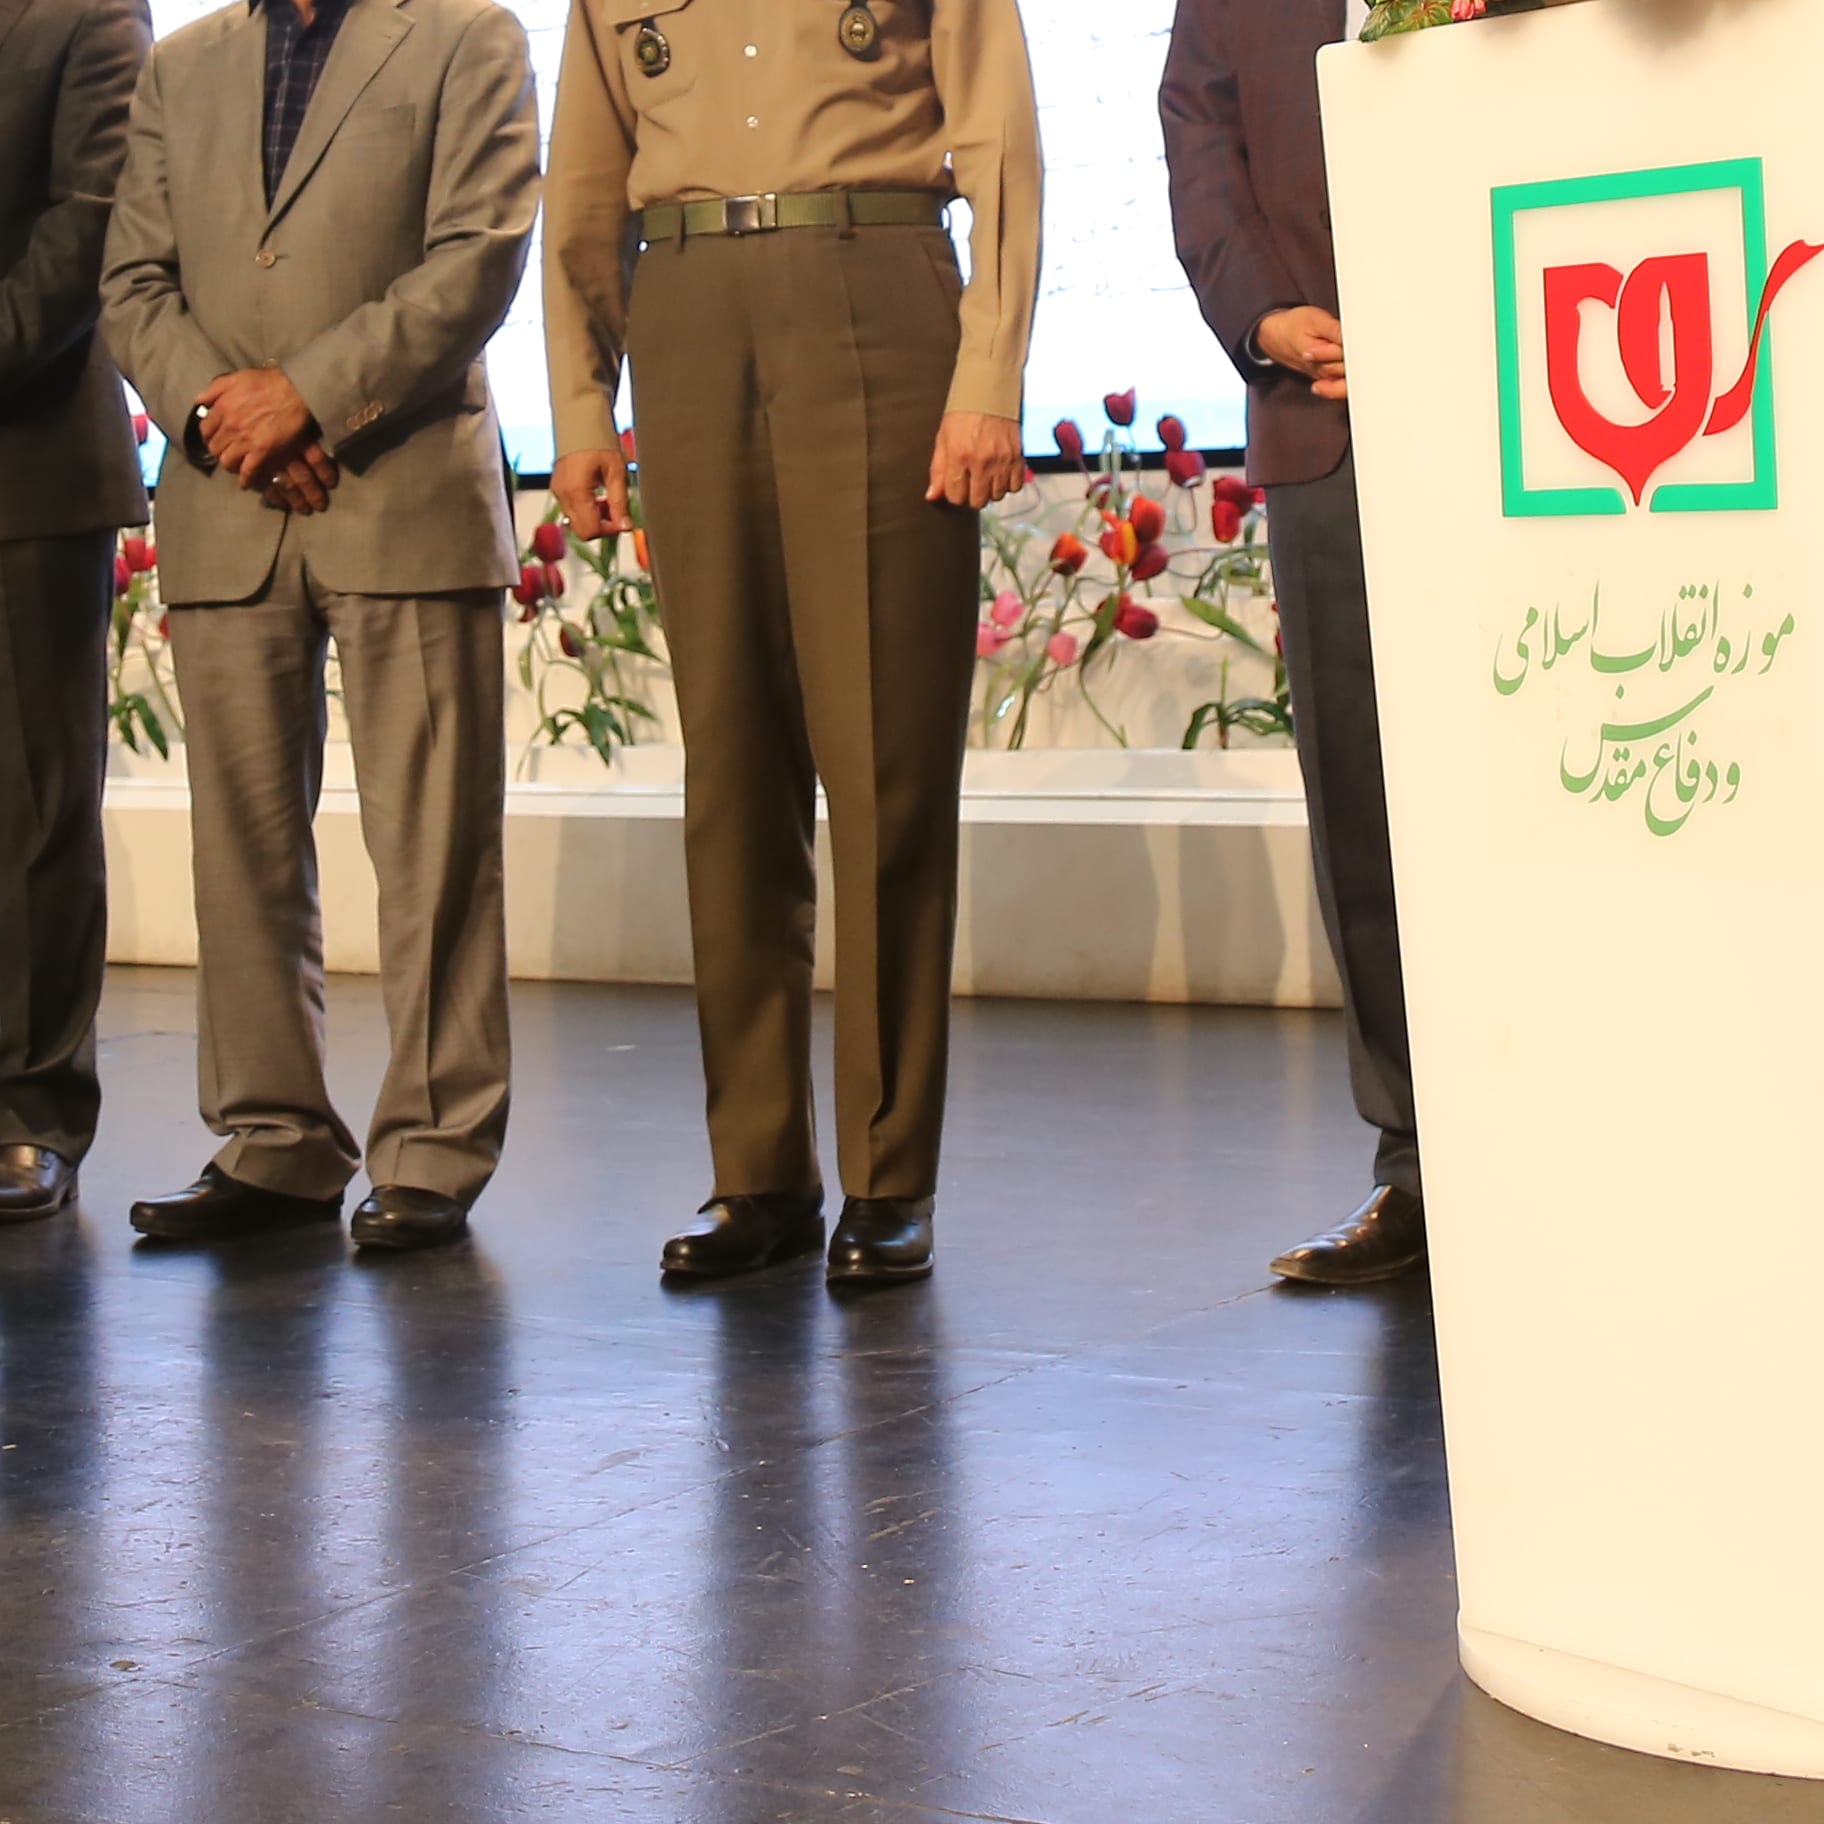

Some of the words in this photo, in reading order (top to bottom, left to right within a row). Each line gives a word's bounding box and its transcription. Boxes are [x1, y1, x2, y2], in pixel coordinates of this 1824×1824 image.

[1492, 577, 1600, 696] اسلامی
[1589, 577, 1720, 700] انقلاب
[1712, 582, 1795, 676] موزه
[1559, 684, 1715, 804] مقدس
[1644, 729, 1719, 838] دفاع
[1722, 760, 1741, 805] و
